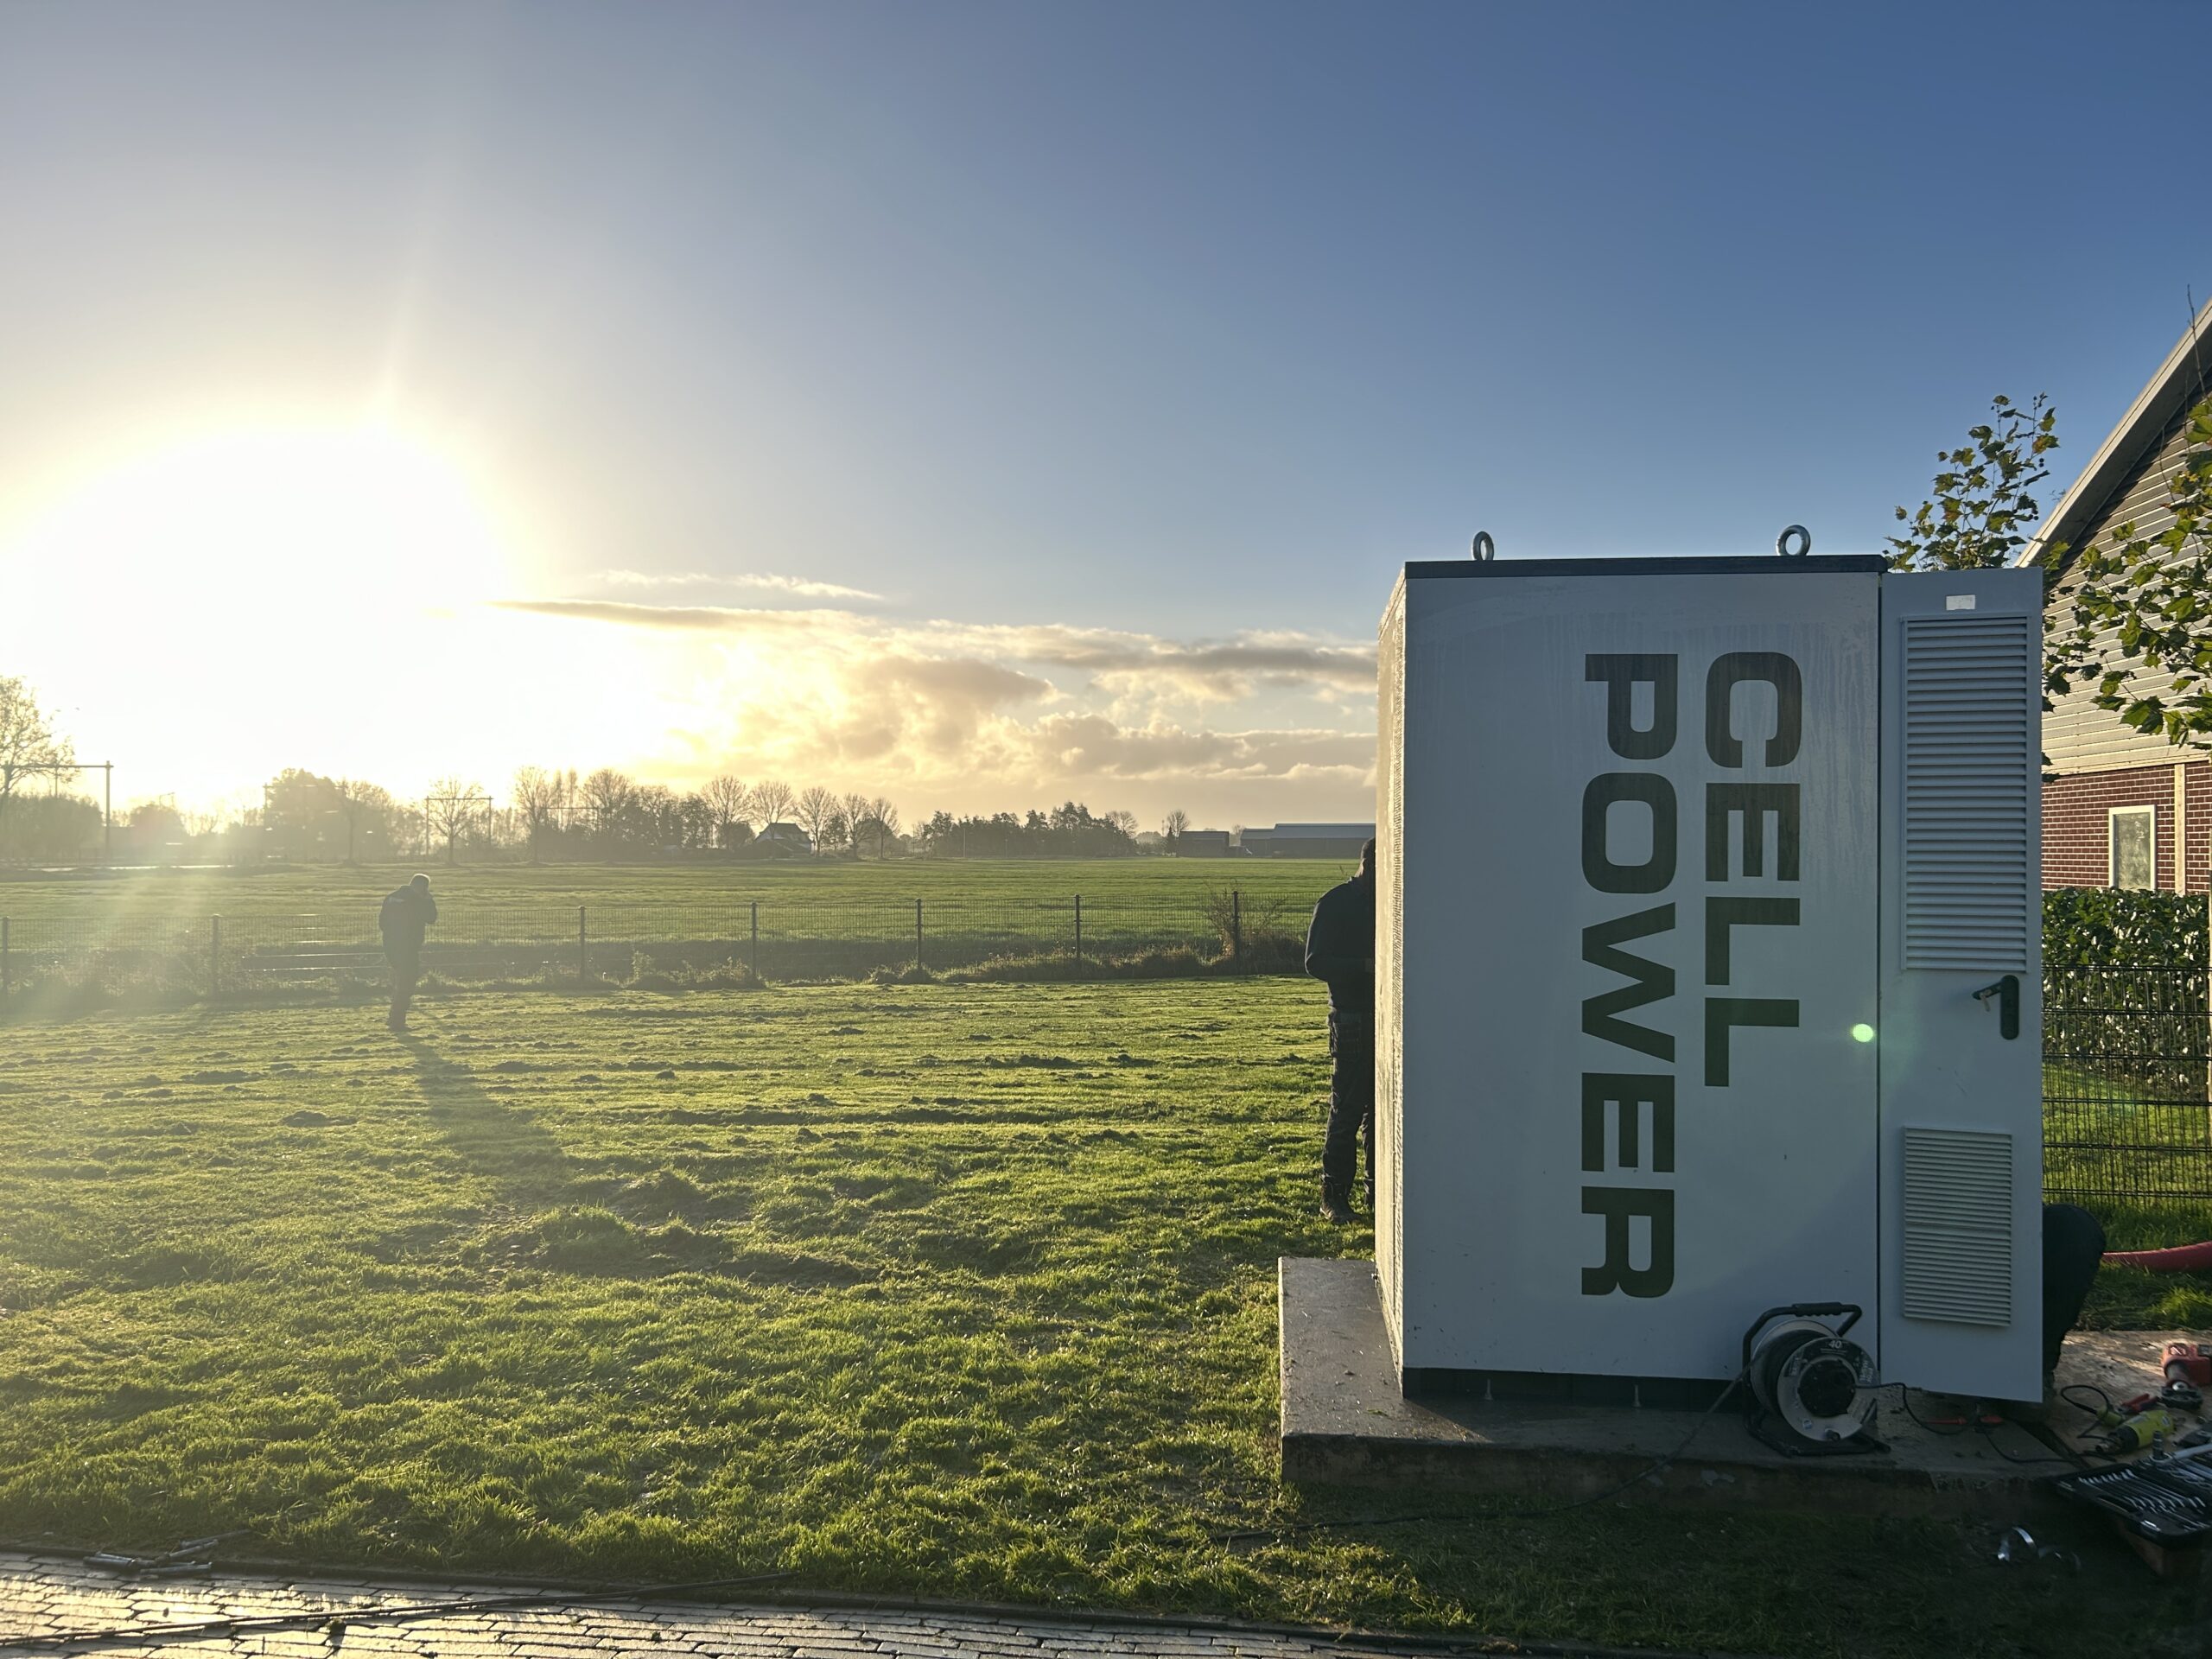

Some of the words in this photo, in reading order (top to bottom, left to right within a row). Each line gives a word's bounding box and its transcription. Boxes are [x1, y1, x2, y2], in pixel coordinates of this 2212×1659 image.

[1581, 653, 1678, 1298] POWER
[1705, 652, 1802, 1087] CELL
[1827, 1340, 1842, 1349] 40
